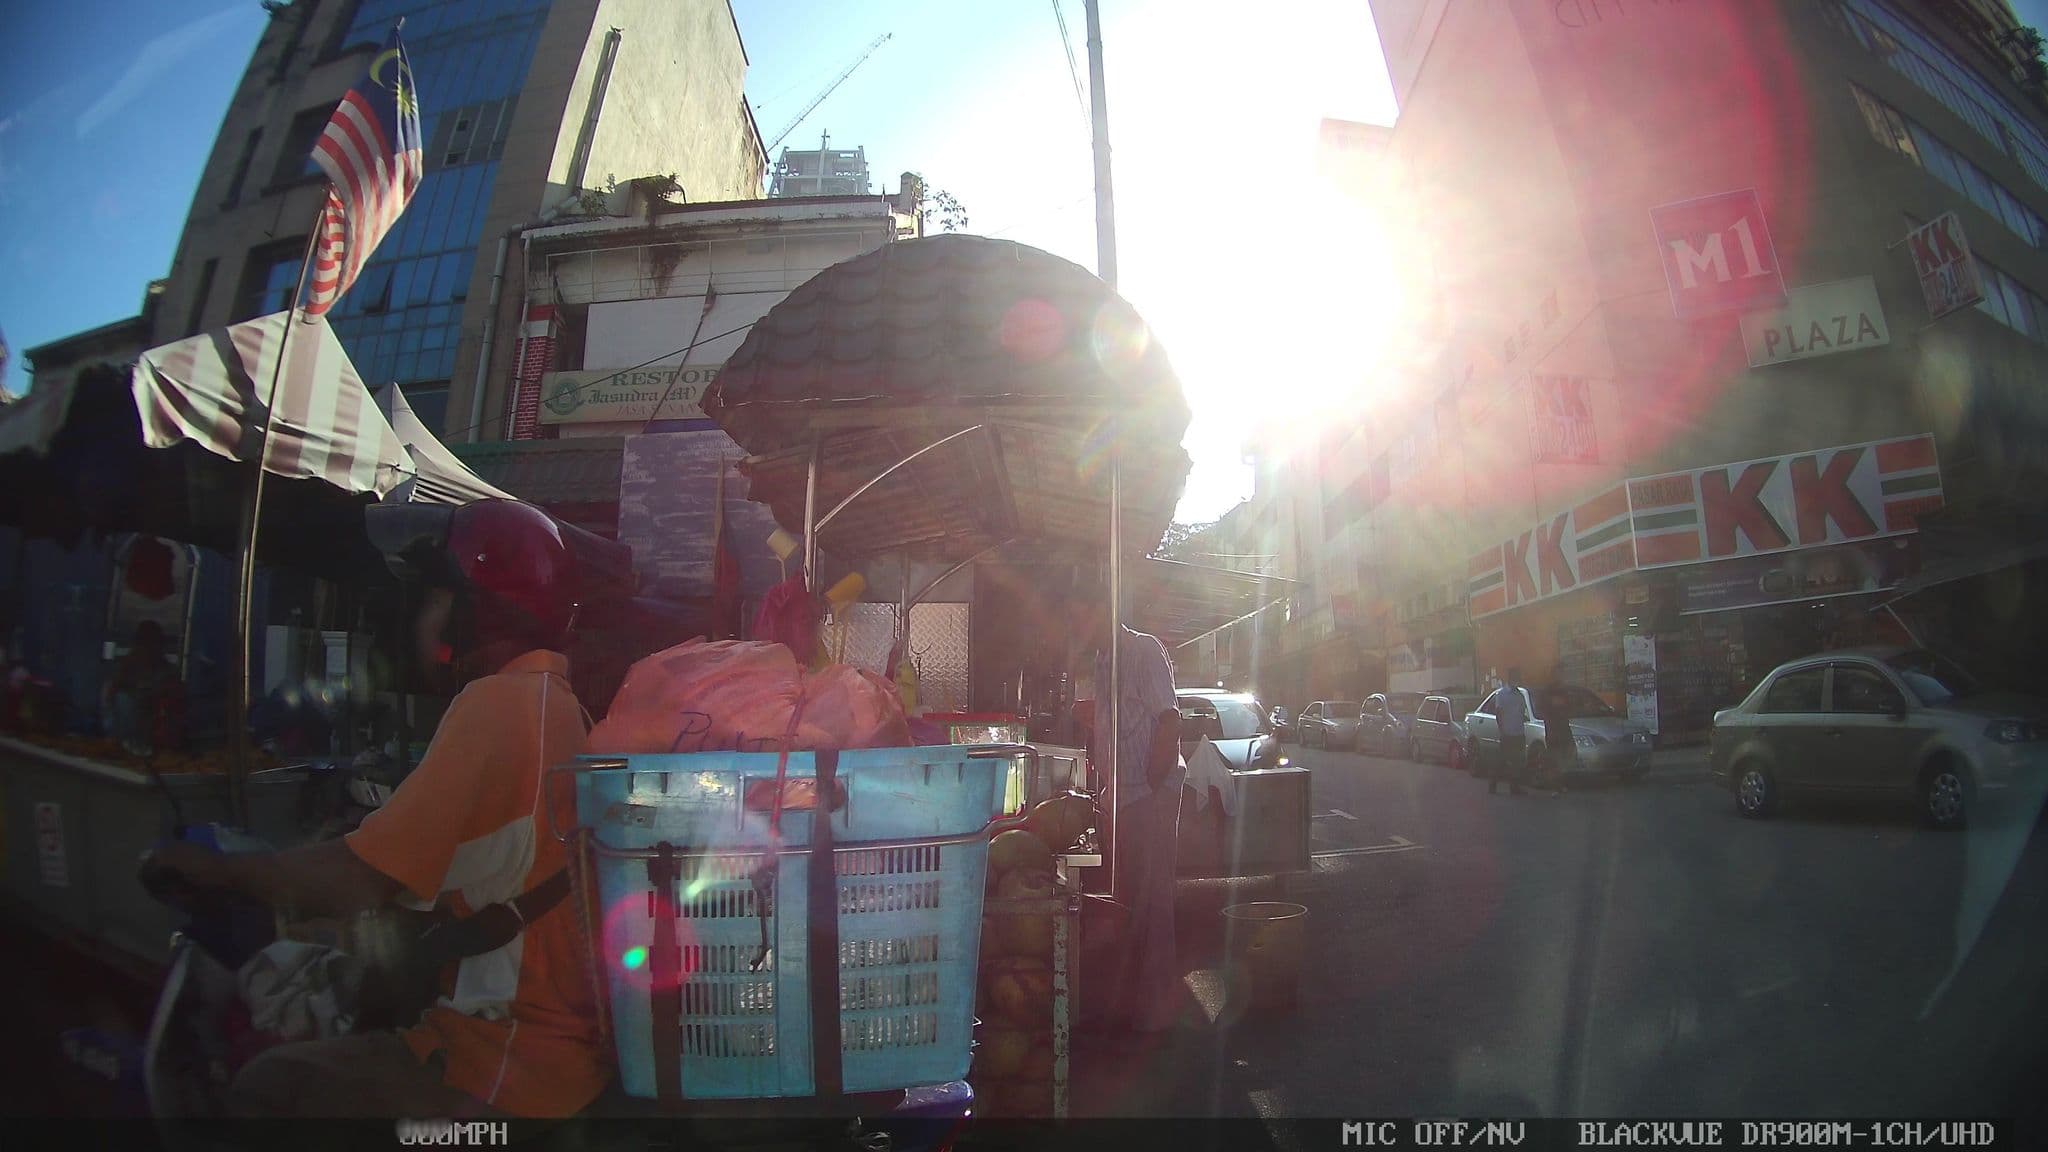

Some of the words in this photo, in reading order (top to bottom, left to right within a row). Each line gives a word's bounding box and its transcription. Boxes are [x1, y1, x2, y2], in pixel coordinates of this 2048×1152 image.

[1668, 217, 1773, 289] M1
[1911, 216, 1963, 275] KK
[1763, 312, 1881, 358] PLAZA
[1700, 447, 1880, 558] KK
[1502, 510, 1576, 606] KK
